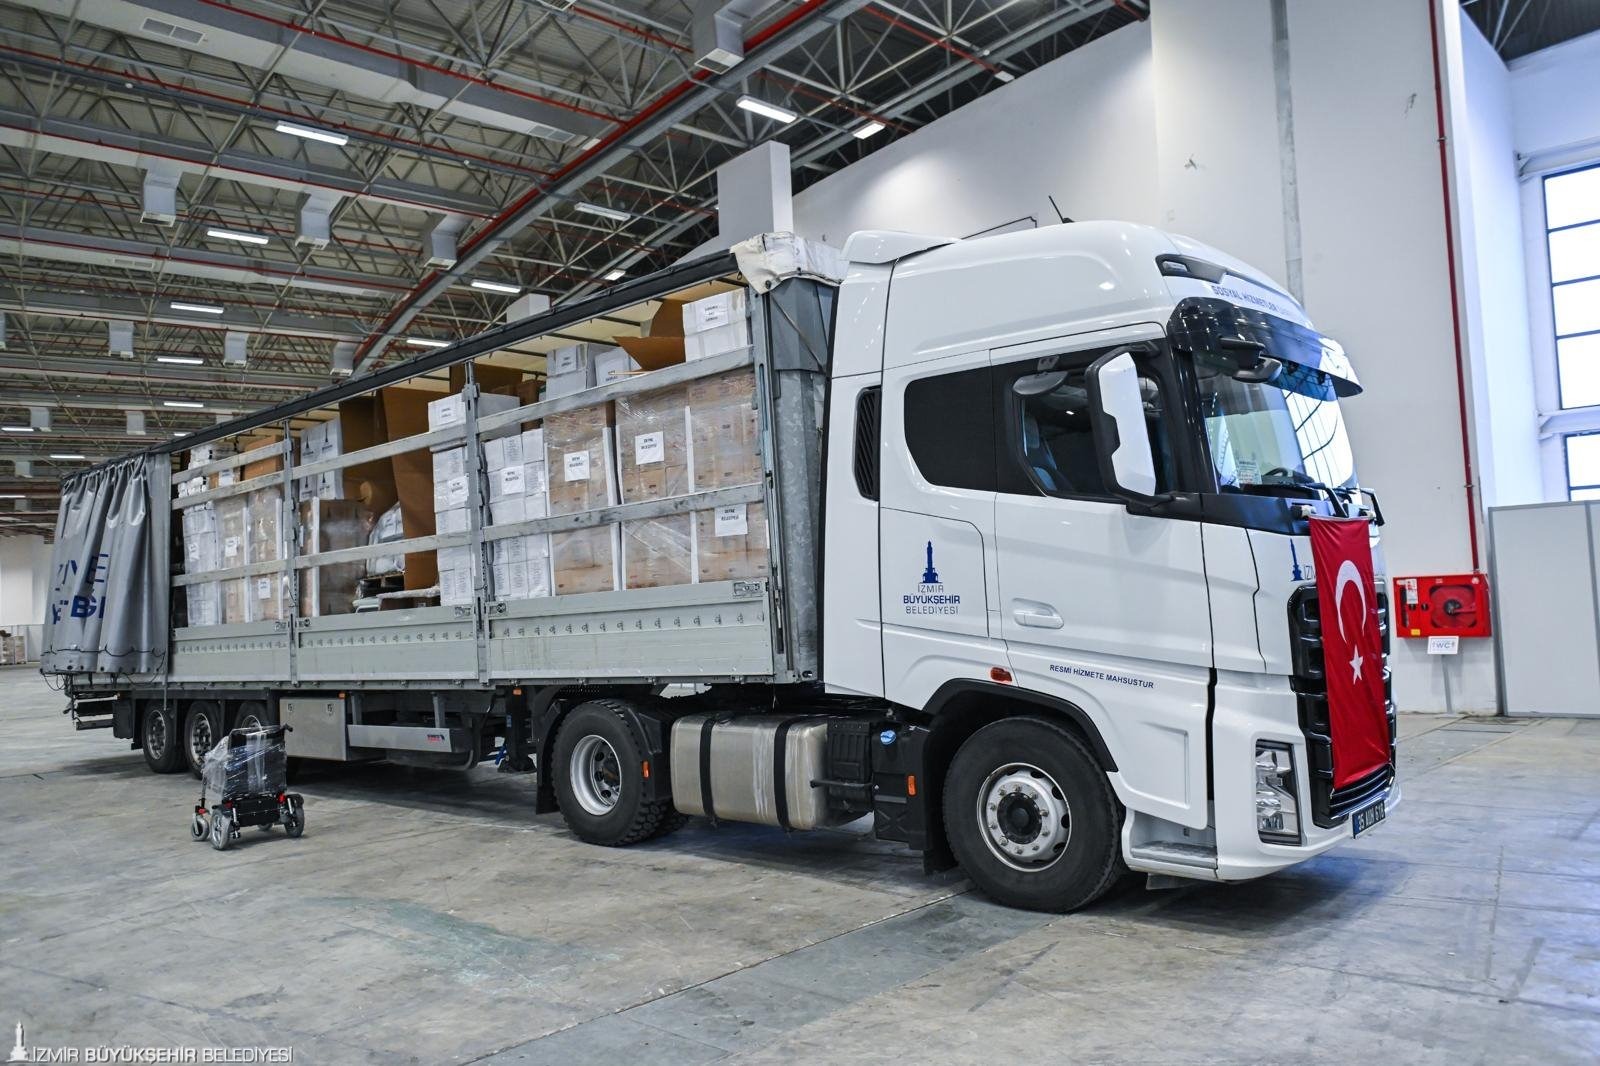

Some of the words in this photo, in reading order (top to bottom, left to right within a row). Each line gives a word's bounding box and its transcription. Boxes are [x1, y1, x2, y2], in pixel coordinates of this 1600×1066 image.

[1211, 285, 1242, 300] SOSYAL
[917, 583, 944, 594] İZMİR
[903, 592, 960, 605] BÜYÜKŞEHİR
[905, 604, 959, 615] BELEDİYESİ
[1436, 641, 1451, 649] WC
[1049, 664, 1072, 675] RESMİ
[1073, 668, 1105, 680] HİZMETE
[1105, 673, 1154, 689] MAHSUSTUR
